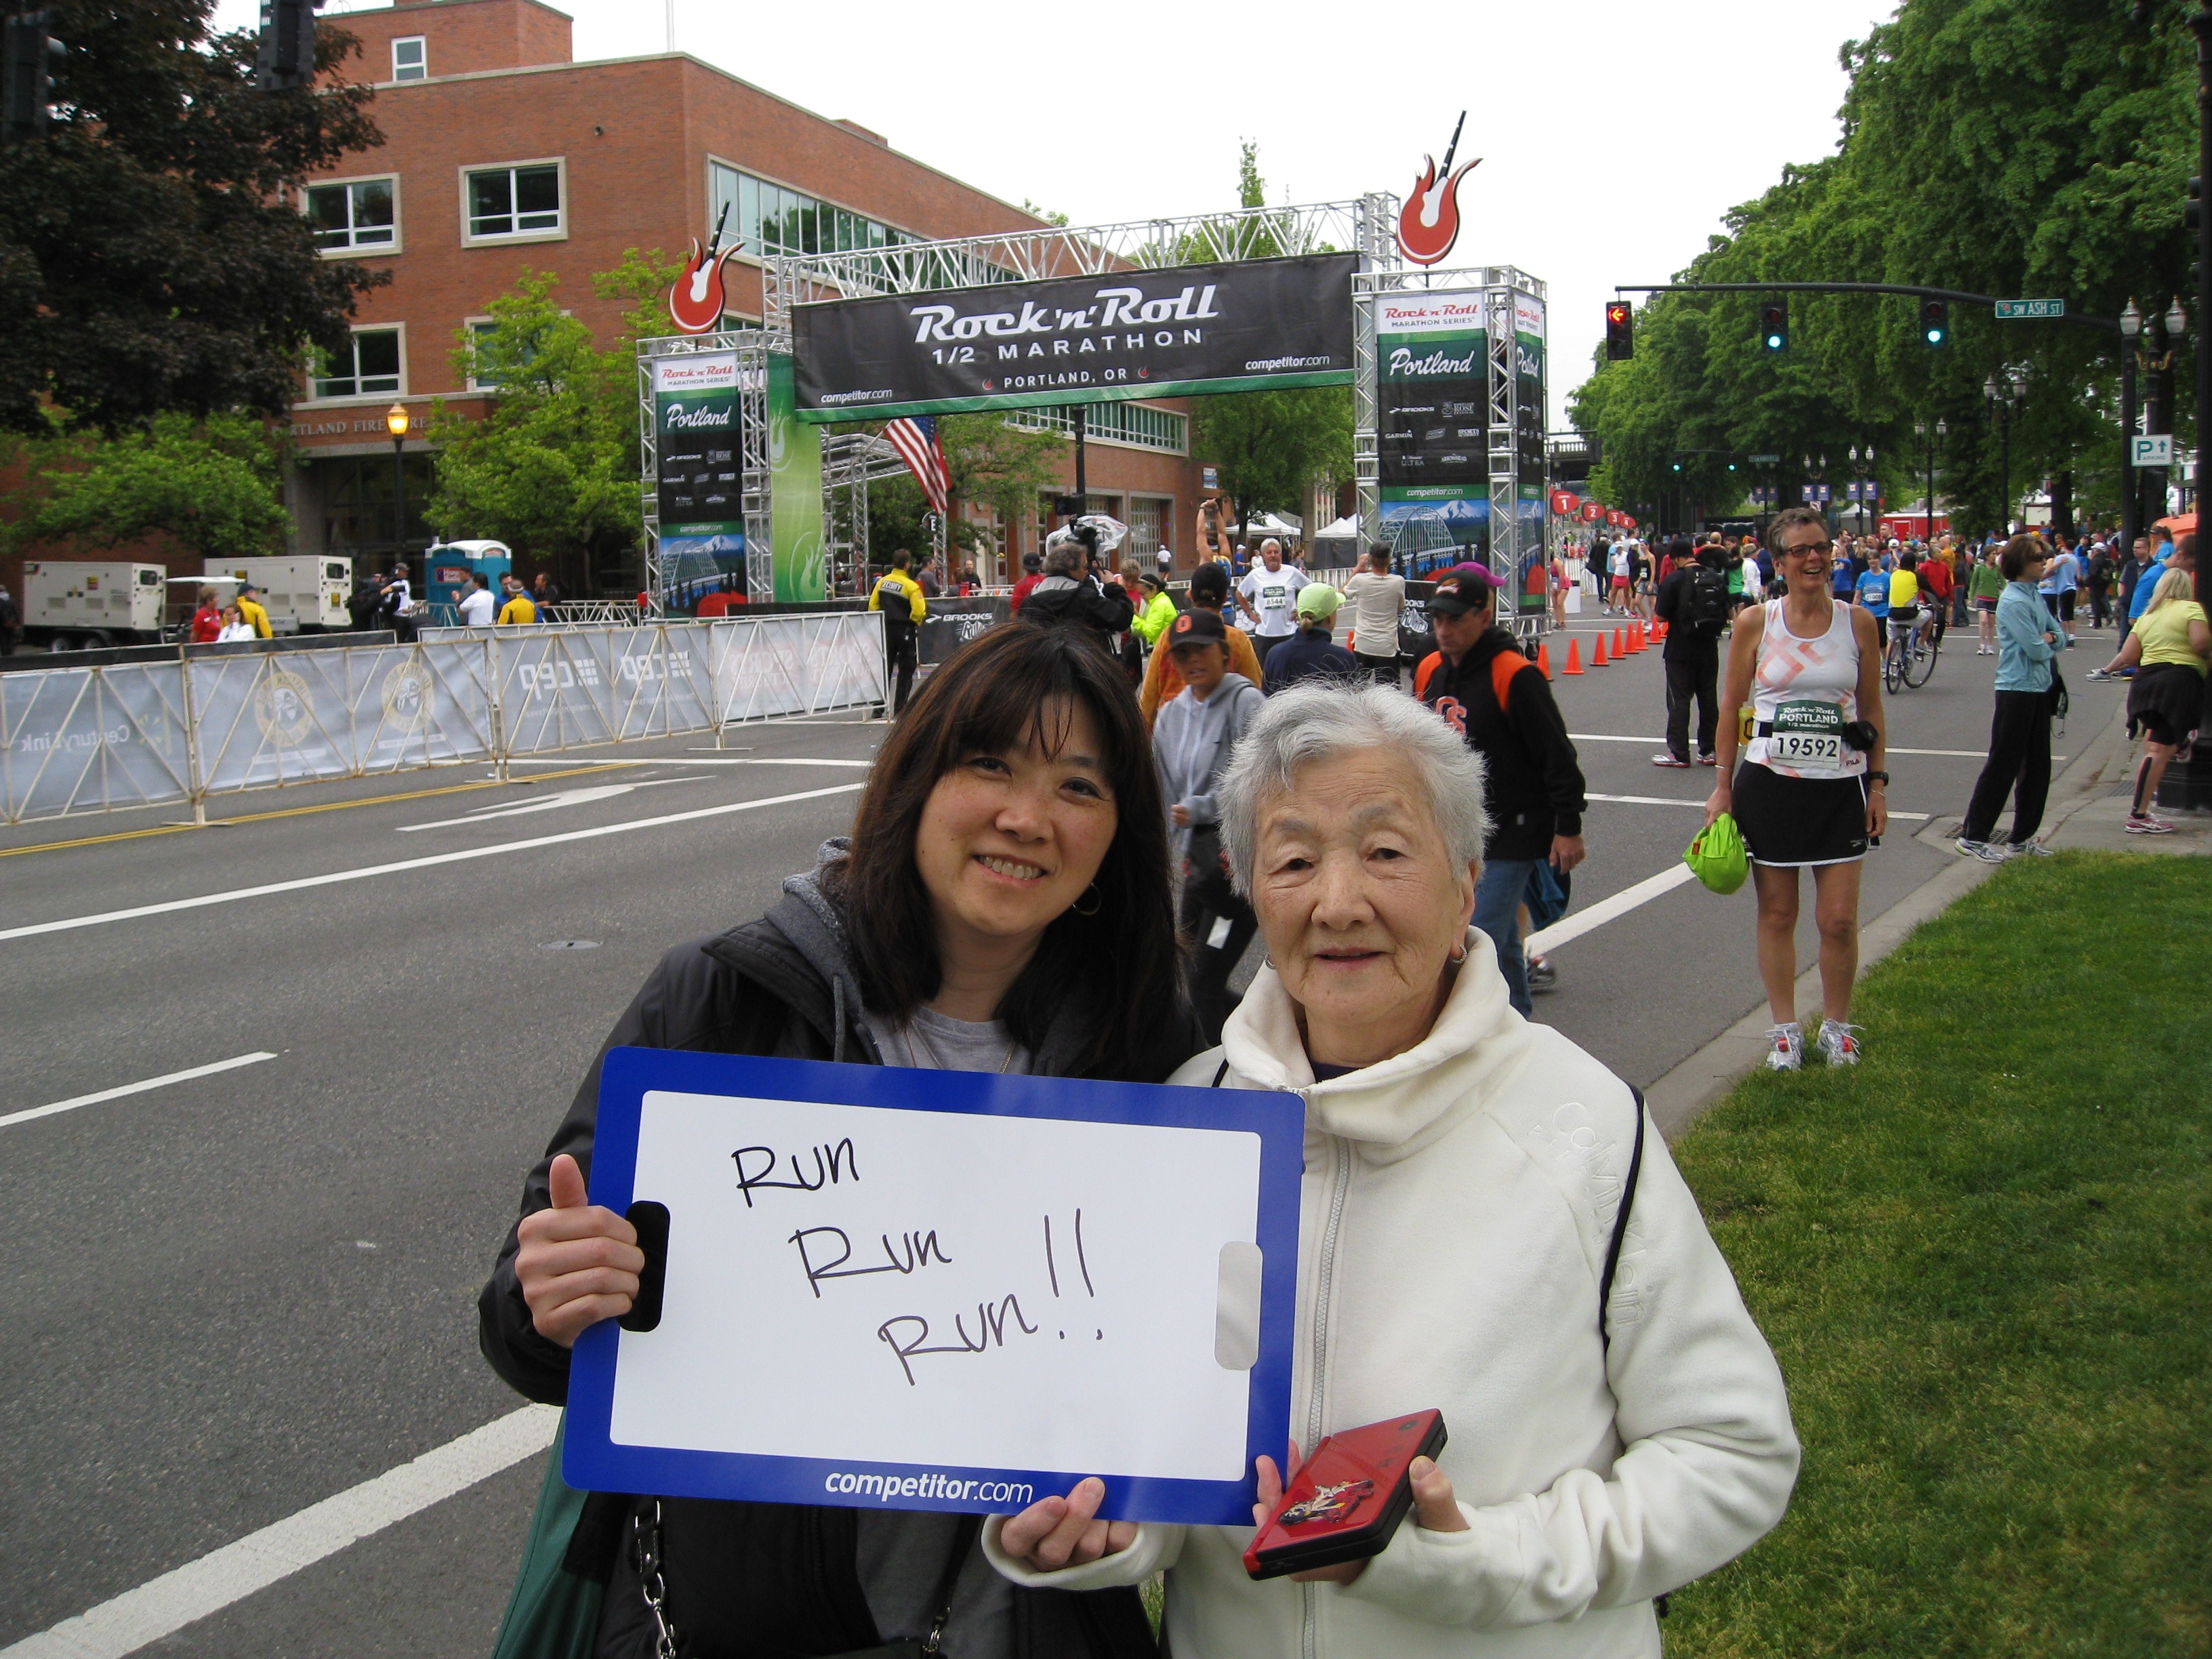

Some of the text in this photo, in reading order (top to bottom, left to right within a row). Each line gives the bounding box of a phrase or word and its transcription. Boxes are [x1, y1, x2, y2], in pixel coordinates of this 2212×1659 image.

[2013, 302, 2060, 315] SW ASH ST
[931, 328, 1202, 365] 1/2 MARATHON
[1246, 354, 1330, 371] competitor.com
[1389, 348, 1475, 376] Portland
[1004, 368, 1127, 388] PORTLAND, OR
[820, 388, 893, 405] competitor.com
[665, 403, 732, 429] Portland
[271, 418, 386, 436] PRTLAND FIRE
[1406, 488, 1463, 497] competitor.com
[1561, 499, 1568, 510] 1
[1590, 508, 1597, 517] 2
[680, 524, 723, 533] competitor.com
[1404, 599, 1425, 608] OOKS
[943, 613, 994, 621] BROOKS
[1778, 713, 1839, 724] PORTLAND
[1778, 737, 1837, 758] 19592
[825, 1472, 1033, 1503] competitor.com
